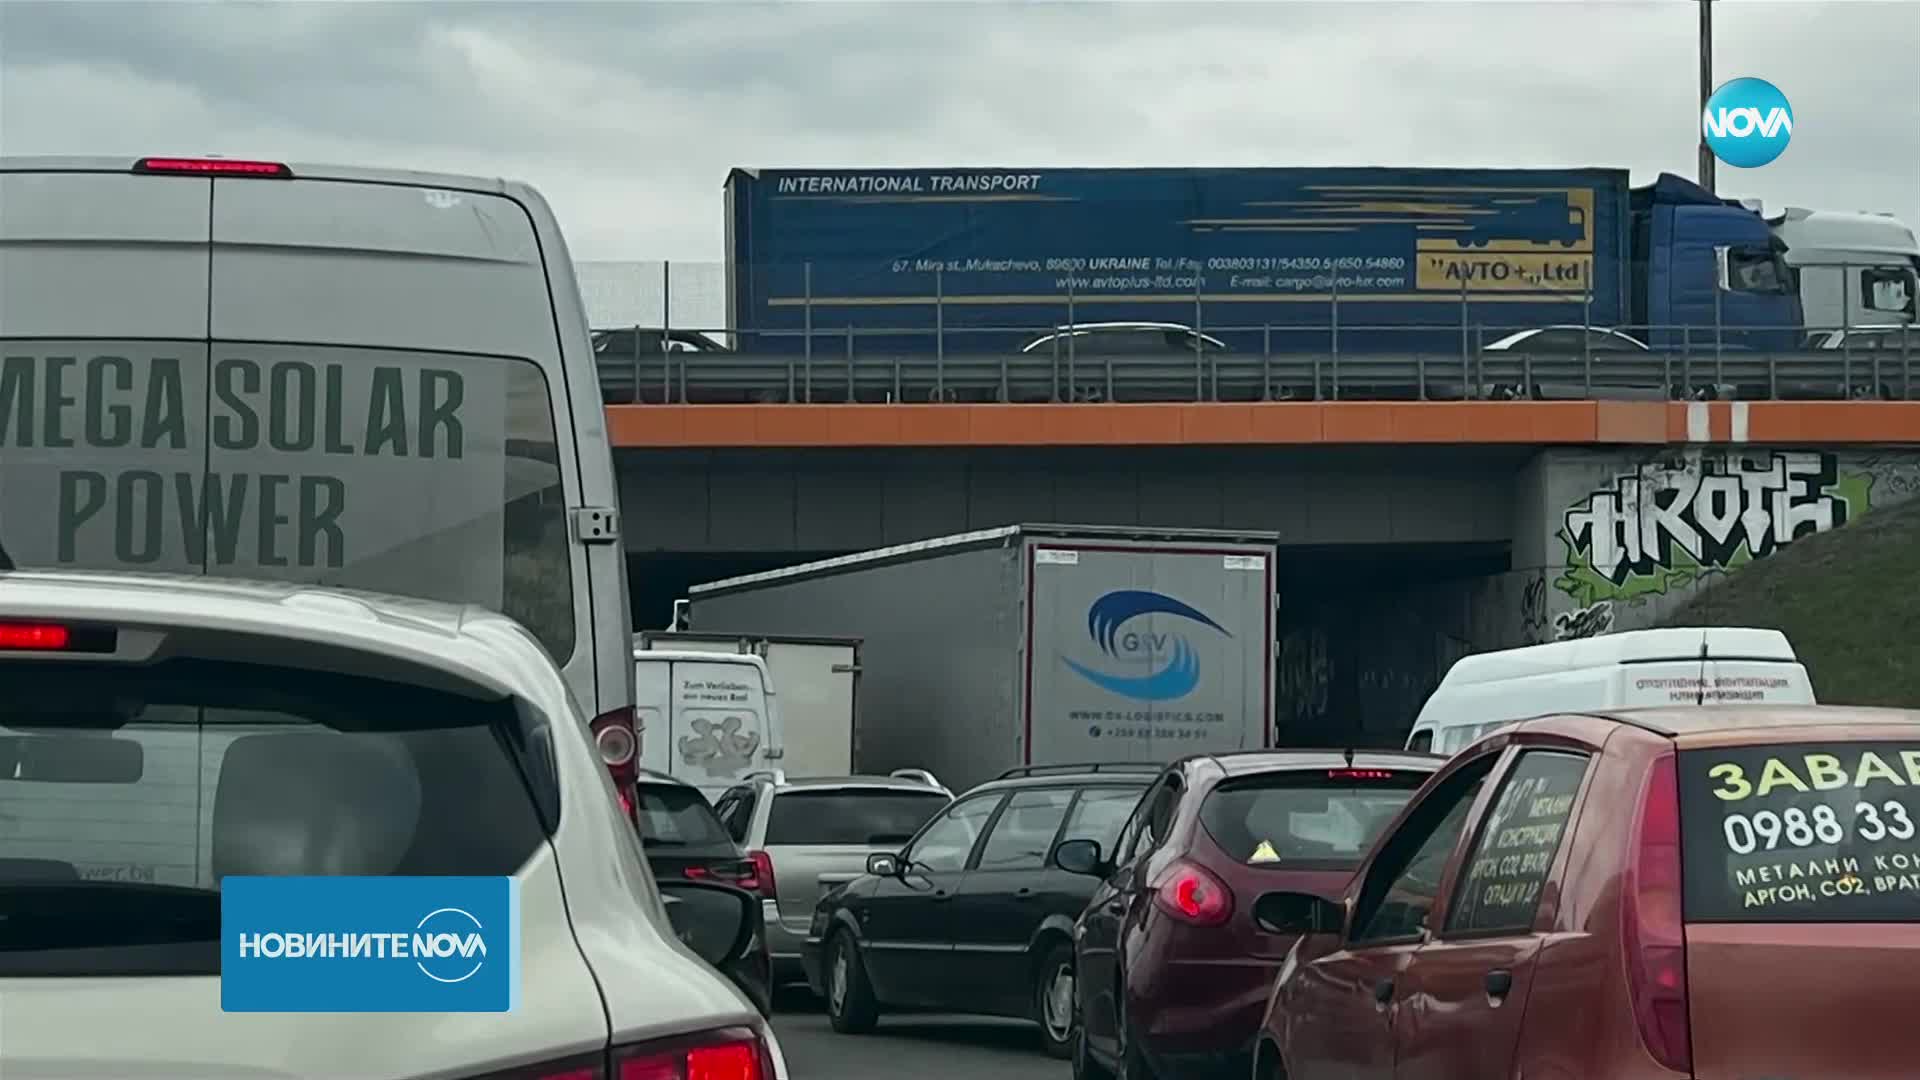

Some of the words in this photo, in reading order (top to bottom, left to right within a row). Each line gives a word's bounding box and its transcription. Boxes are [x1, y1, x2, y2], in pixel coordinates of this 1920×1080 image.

[778, 176, 923, 193] INTERNATIONAL
[930, 174, 1042, 192] TRANSPORT
[915, 258, 944, 272] Mira
[1089, 257, 1151, 271] UKRAINE
[0, 356, 187, 449] MEGA
[213, 359, 464, 459] SOLAR
[57, 469, 345, 568] POWER
[1723, 804, 1844, 855] 0988
[1855, 800, 1916, 842] 33
[1735, 857, 1860, 887] МЕТАЛНИ
[1744, 883, 1816, 909] АРГОН,
